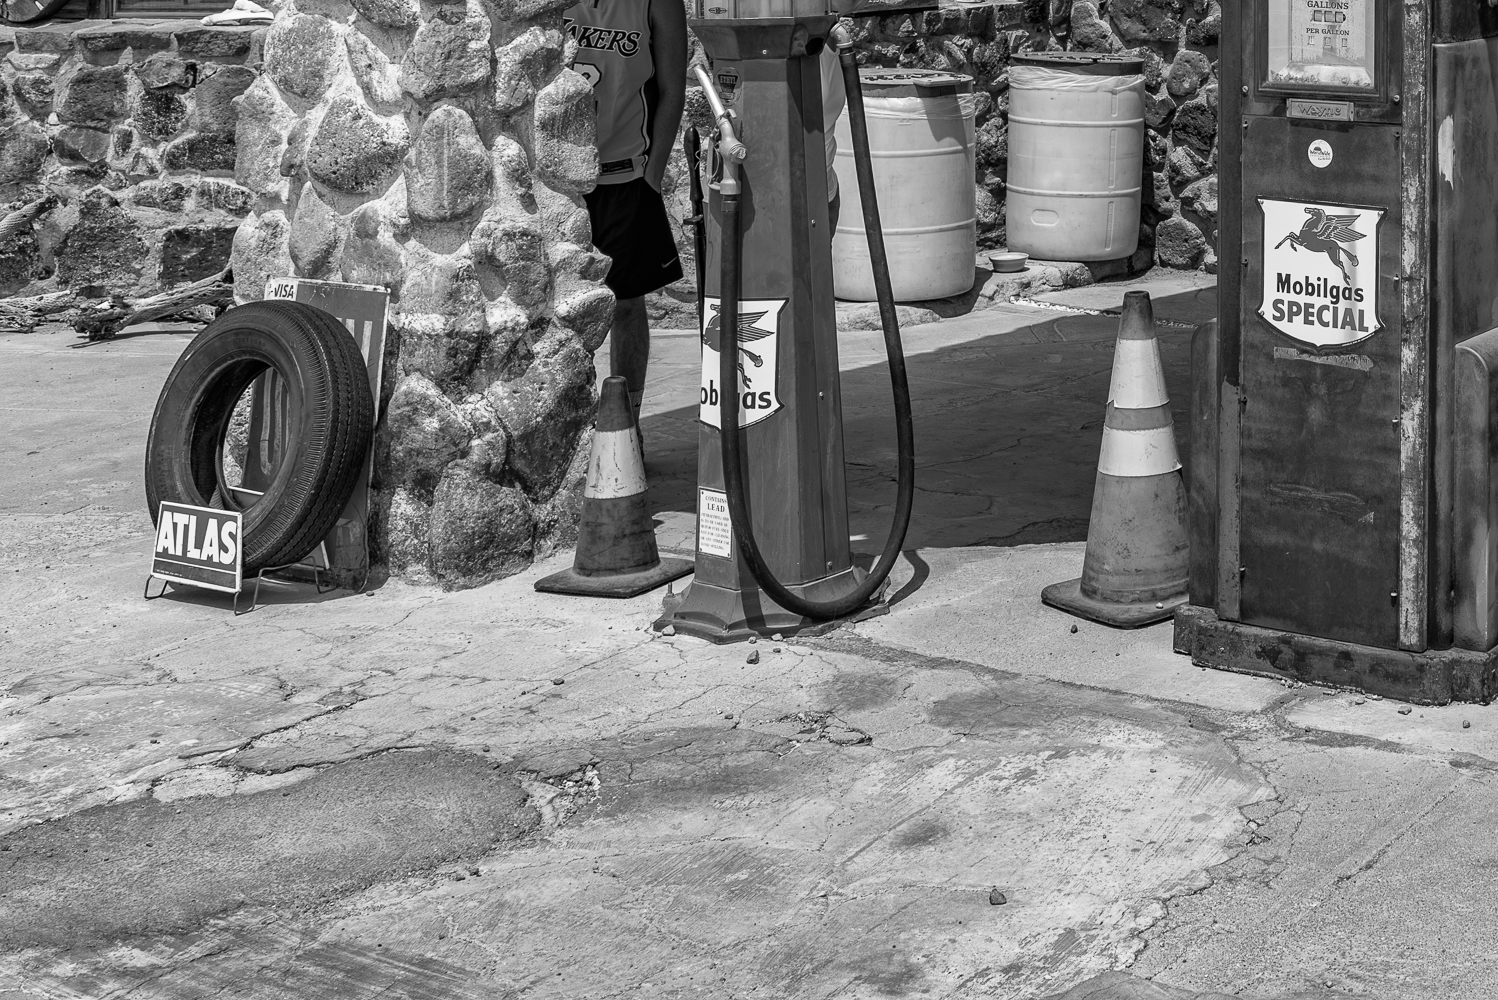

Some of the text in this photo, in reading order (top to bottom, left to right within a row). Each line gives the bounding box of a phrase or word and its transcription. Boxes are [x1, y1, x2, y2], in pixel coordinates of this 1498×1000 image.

[1307, 1, 1349, 10] GALLONS
[1298, 104, 1341, 117] Wayne
[1276, 273, 1364, 304] Mobilgas
[1272, 299, 1369, 332] SPECIAL
[707, 503, 725, 512] LEAD
[157, 511, 237, 564] ATLAS
